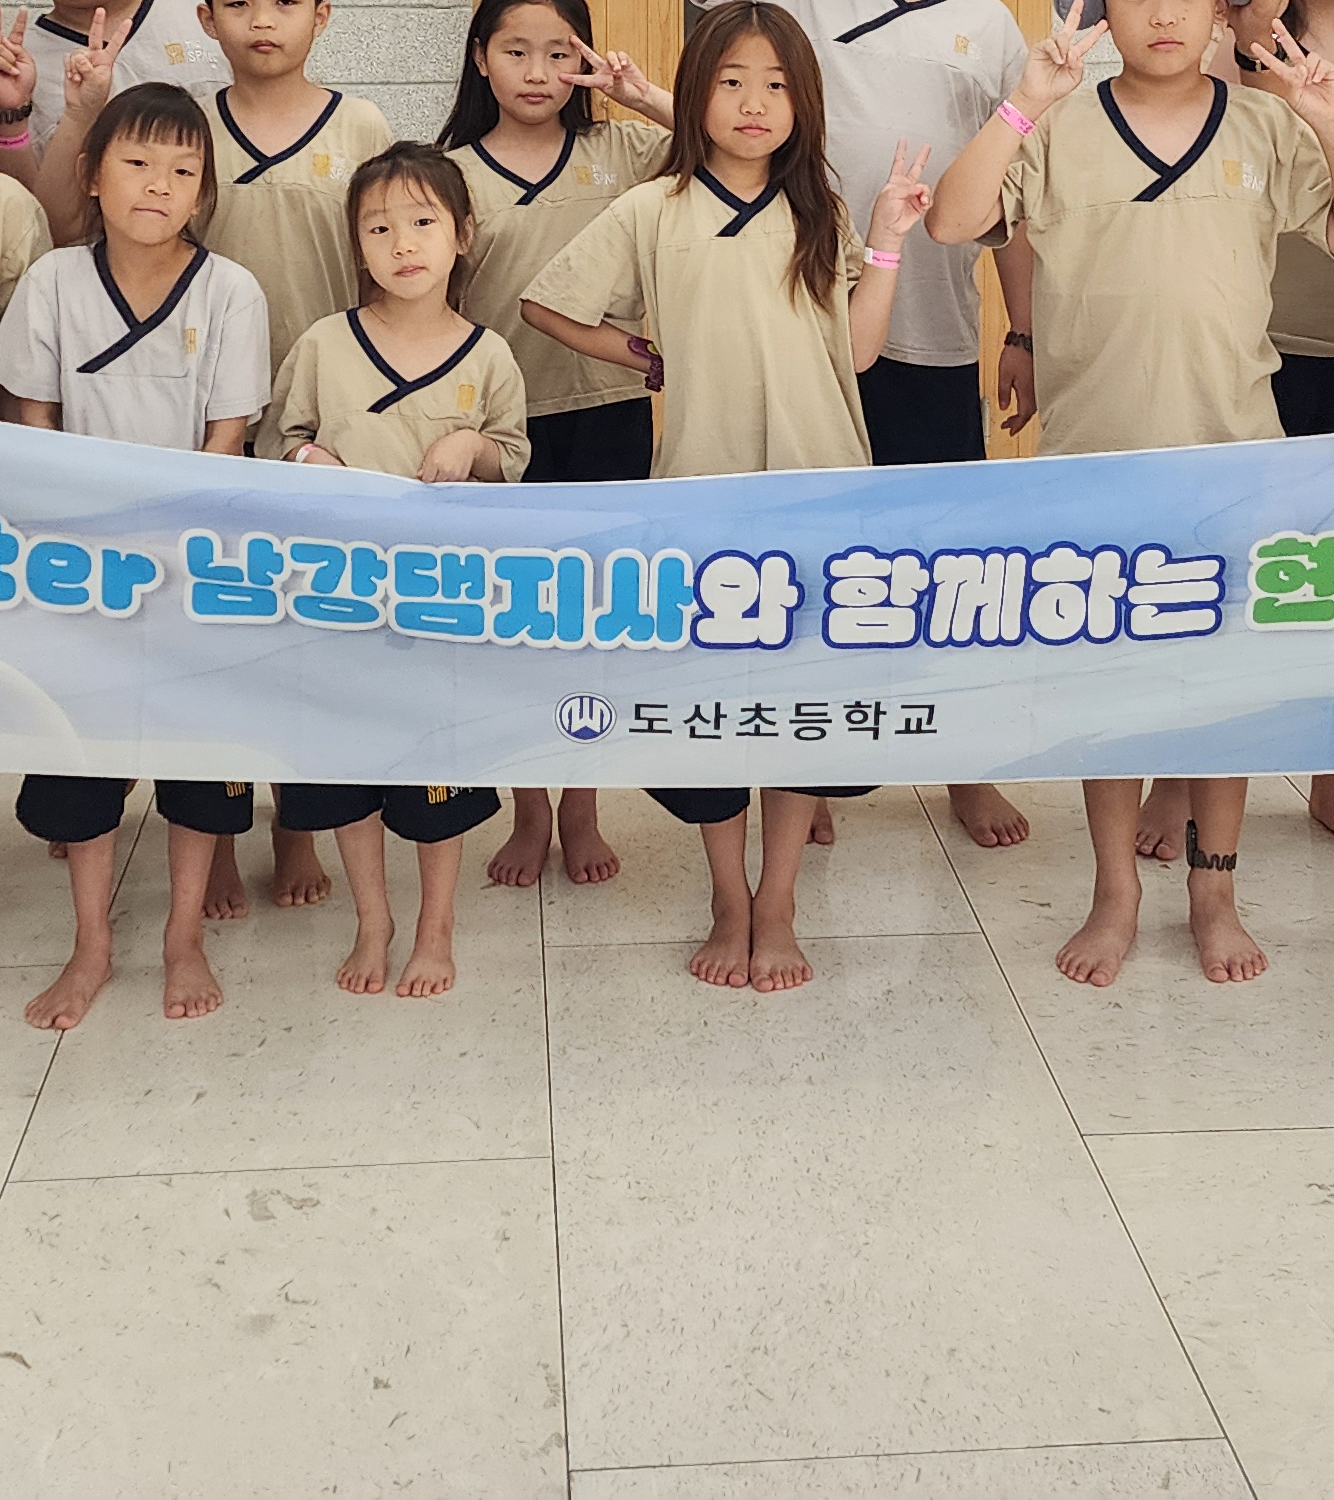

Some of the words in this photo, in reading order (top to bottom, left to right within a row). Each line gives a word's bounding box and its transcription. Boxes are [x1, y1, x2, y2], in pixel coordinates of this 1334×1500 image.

[184, 534, 805, 650] 남강댐지사와
[822, 540, 1226, 649] 함께하는
[627, 700, 938, 742] 도산초등학교
